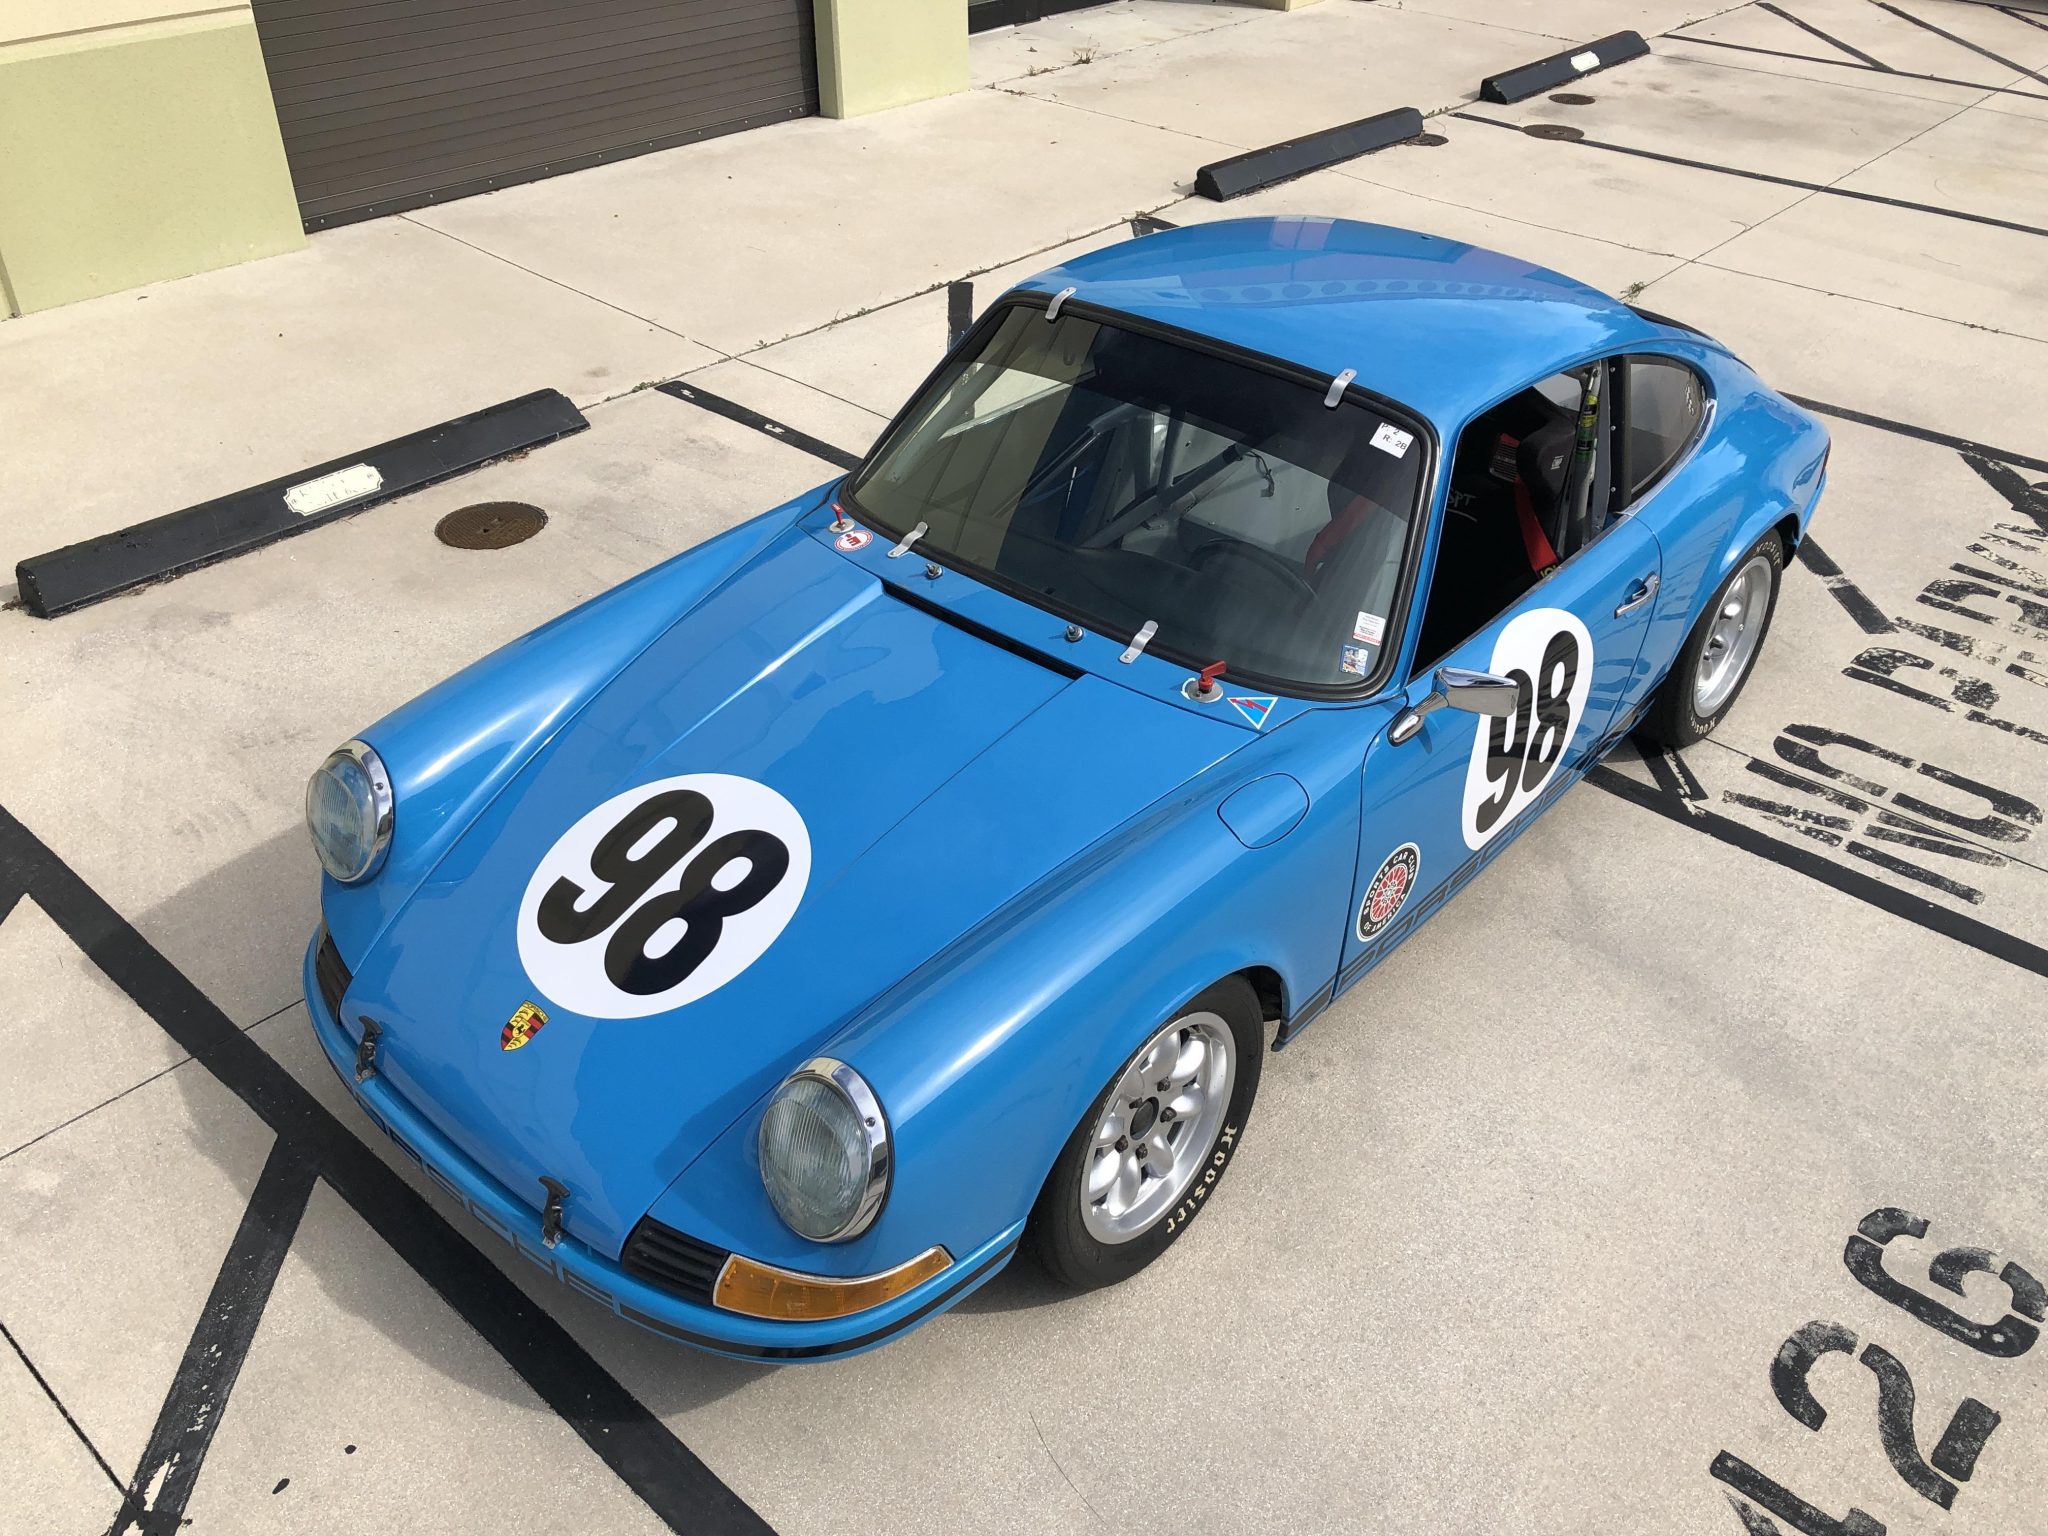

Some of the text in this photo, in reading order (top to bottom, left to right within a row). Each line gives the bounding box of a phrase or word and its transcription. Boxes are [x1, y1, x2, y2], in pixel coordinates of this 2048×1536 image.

[1476, 630, 1579, 833] 98
[1363, 851, 1416, 915] SPORTS CAR CLUB
[1722, 723, 2044, 905] NO
[537, 789, 790, 996] 98
[1363, 893, 1406, 933] OF AMERICA
[1167, 1122, 1238, 1234] Hoosier
